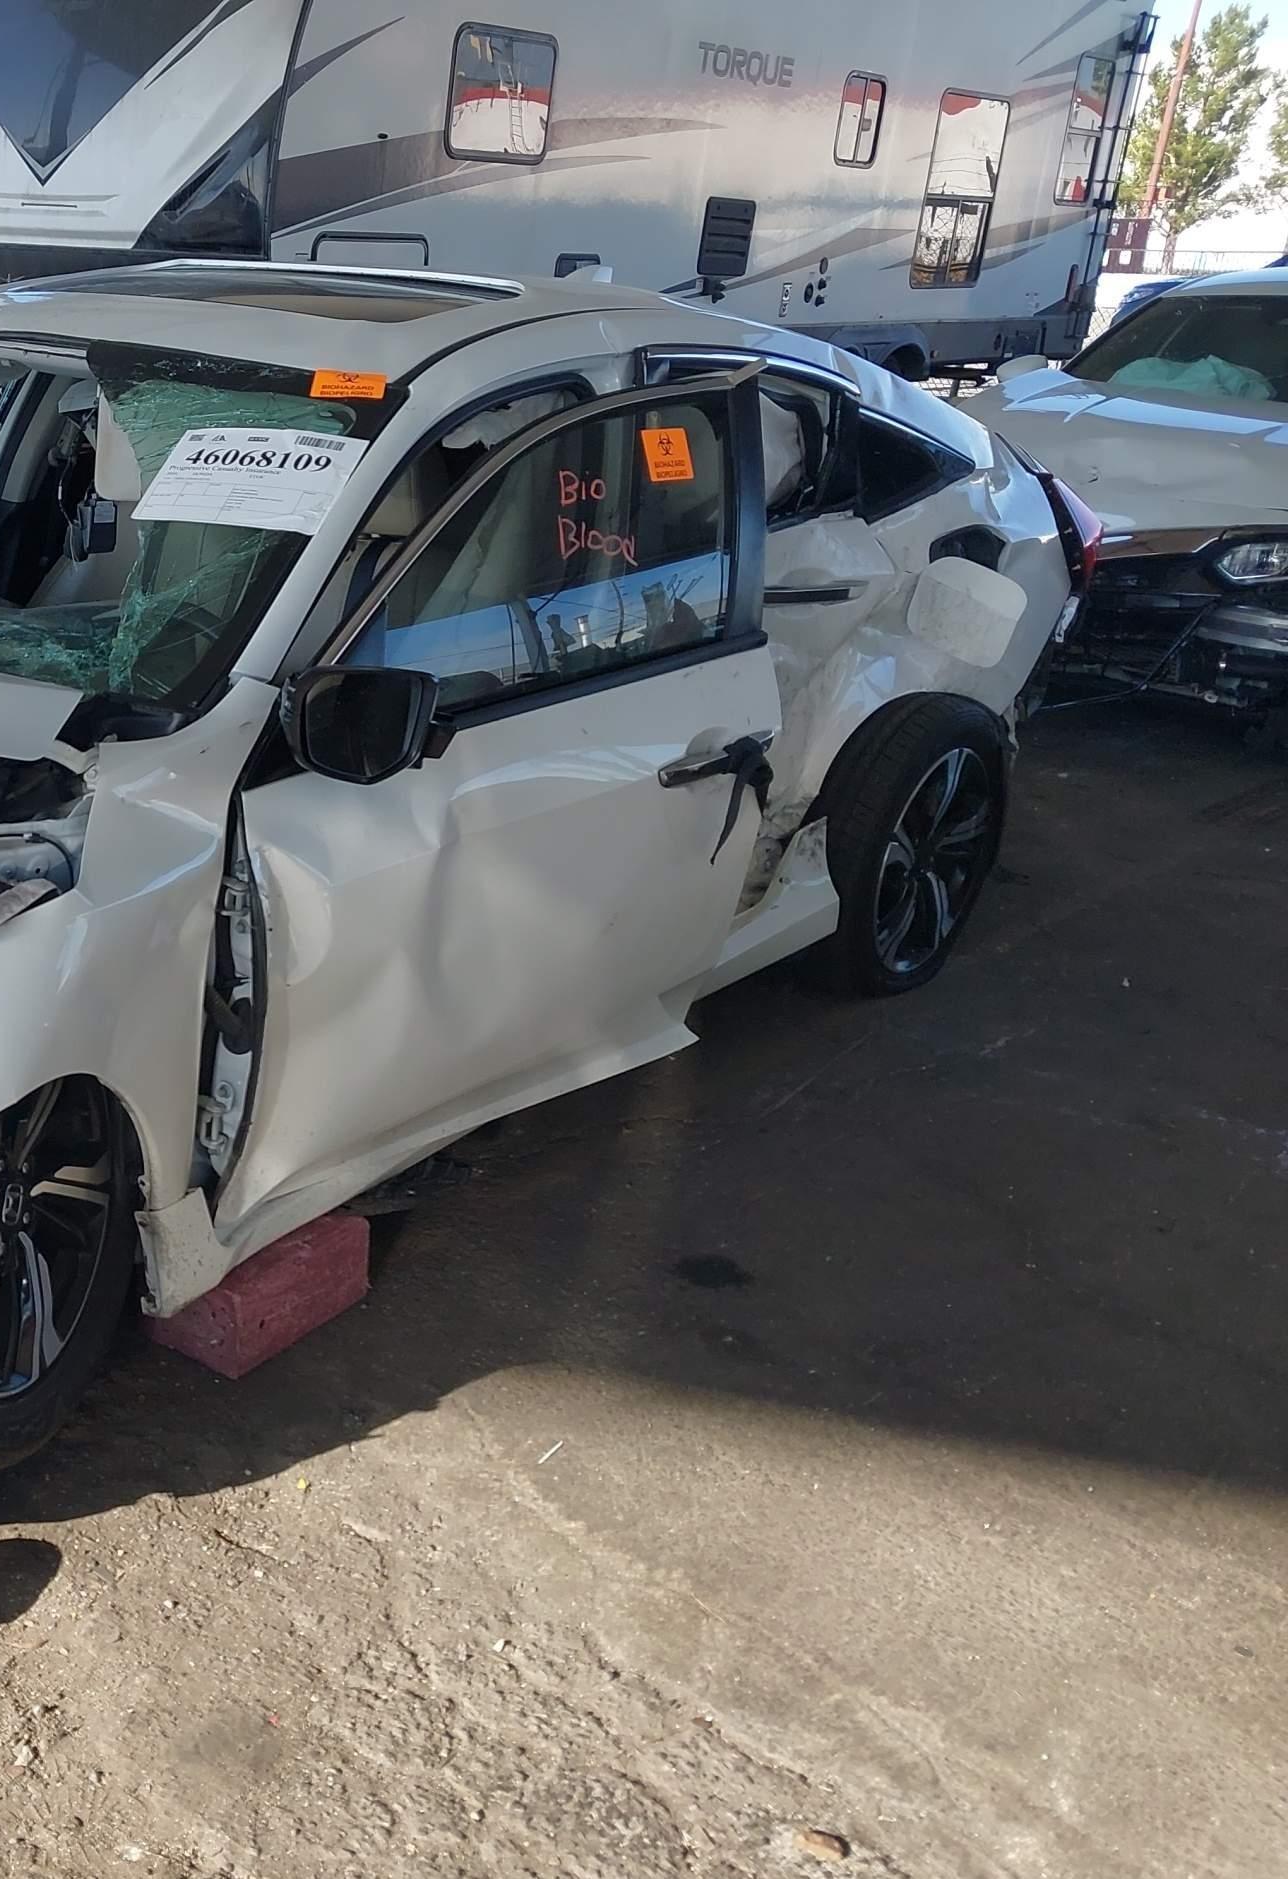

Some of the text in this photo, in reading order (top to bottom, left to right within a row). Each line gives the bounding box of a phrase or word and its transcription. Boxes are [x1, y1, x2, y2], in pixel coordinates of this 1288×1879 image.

[698, 41, 795, 88] TORQUE
[169, 465, 281, 475] Progressive Casualty Insurance
[185, 448, 332, 473] 46068109
